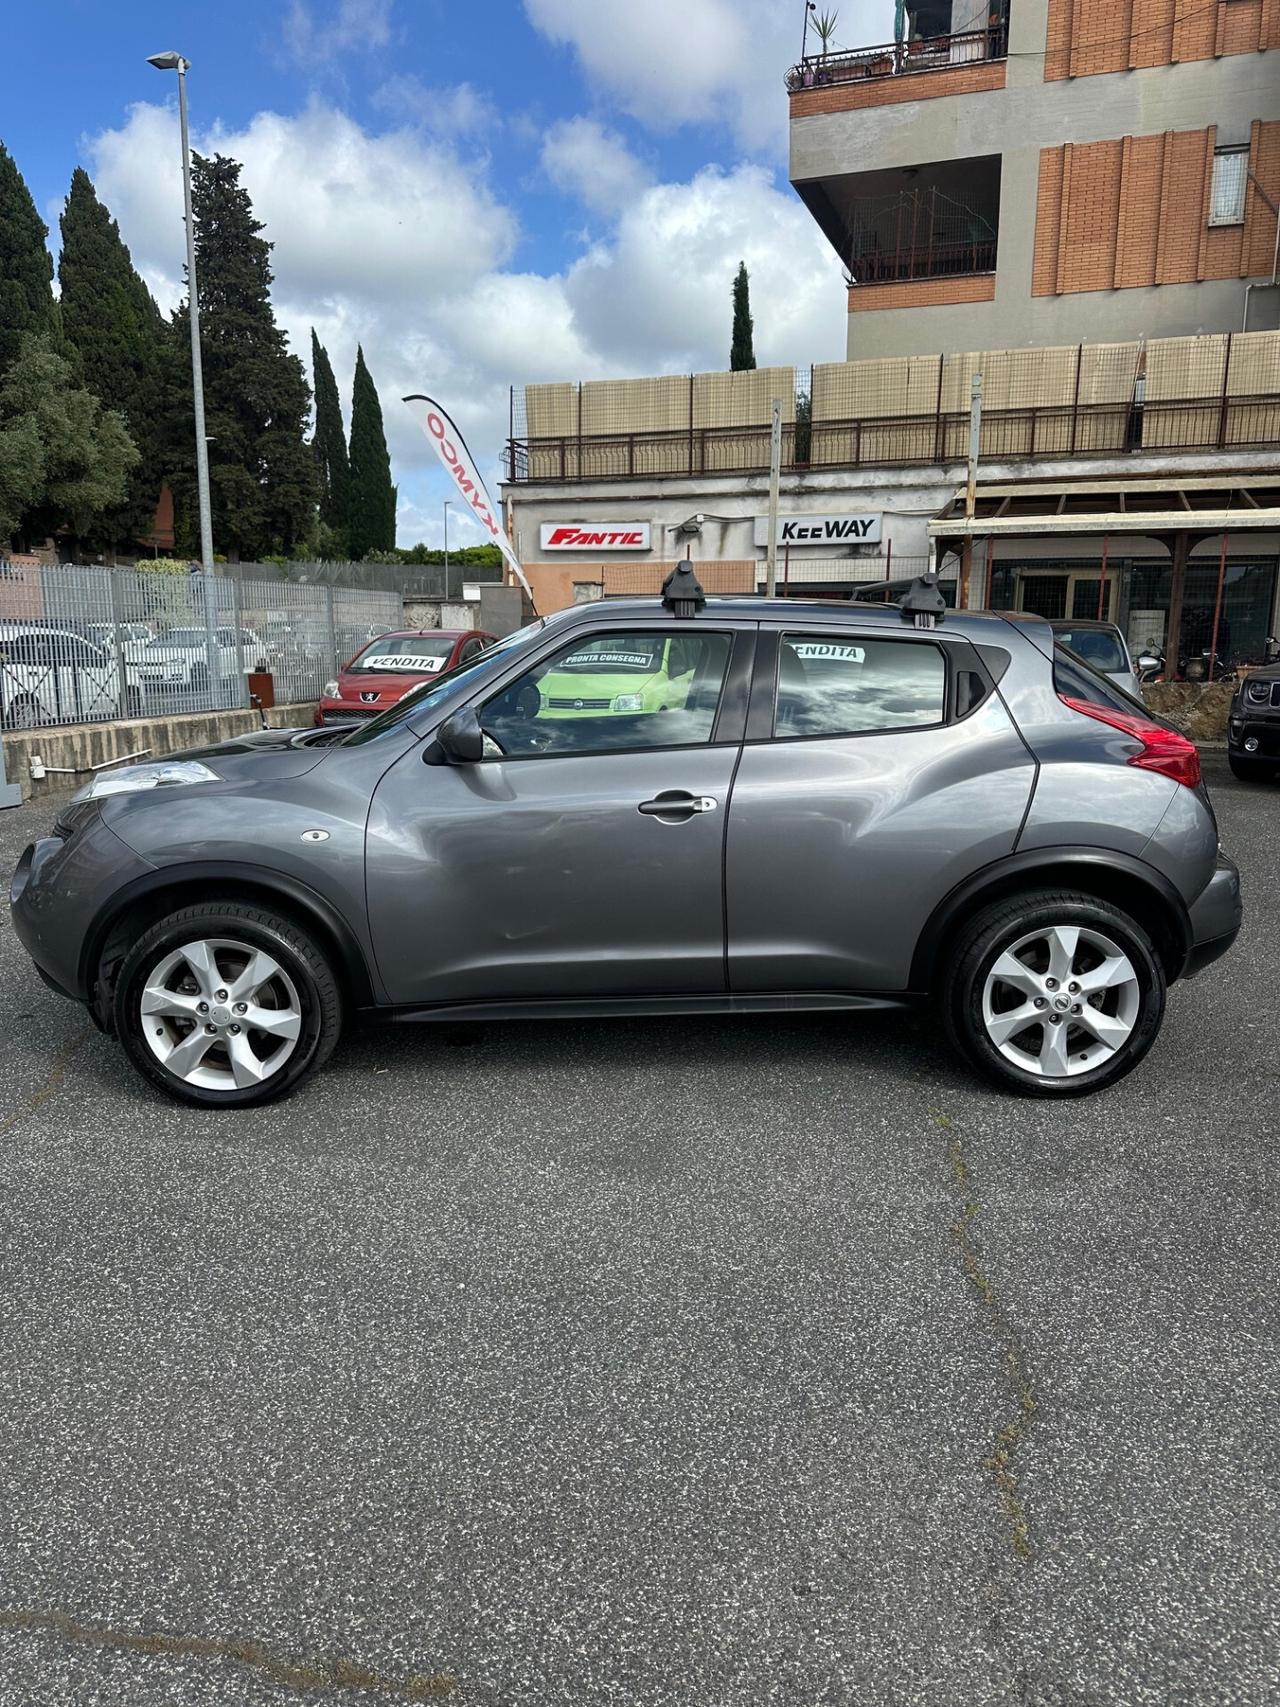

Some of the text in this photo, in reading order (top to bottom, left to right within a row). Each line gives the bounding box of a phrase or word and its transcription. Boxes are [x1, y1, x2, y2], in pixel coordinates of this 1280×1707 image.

[547, 528, 643, 545] FANTIC
[795, 645, 857, 658] ENDITA
[373, 657, 435, 669] VENDITA
[566, 654, 646, 665] PRONTA CONSEGNA
